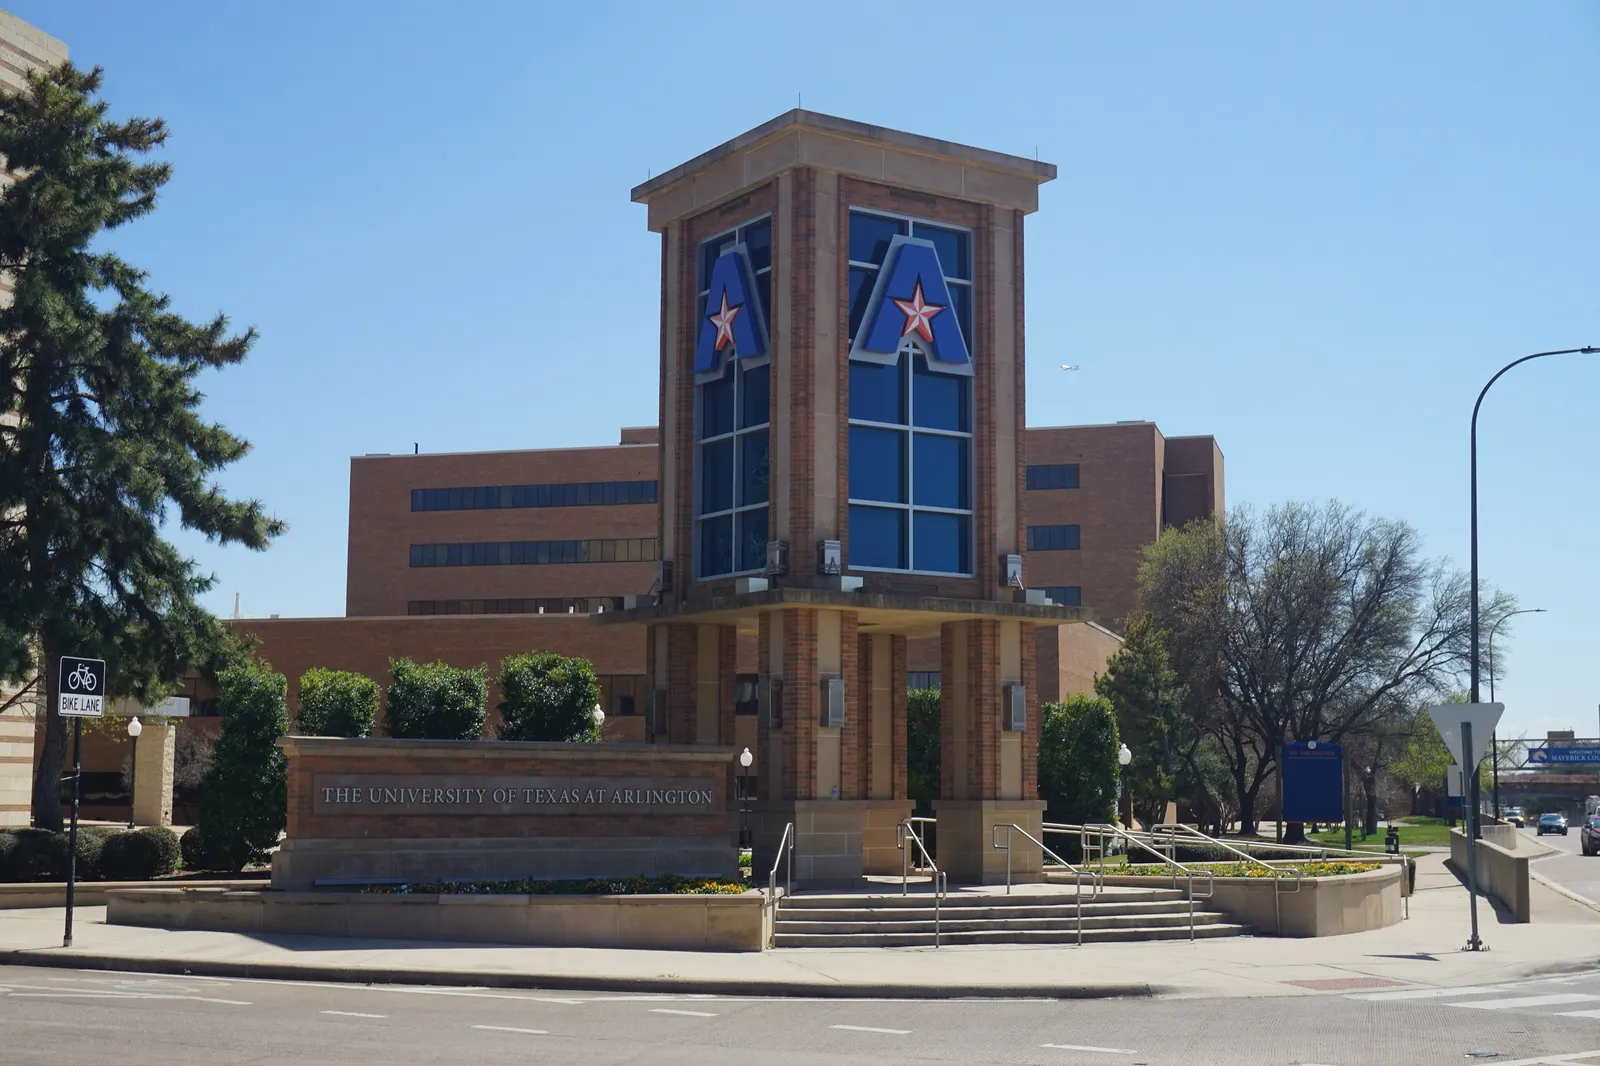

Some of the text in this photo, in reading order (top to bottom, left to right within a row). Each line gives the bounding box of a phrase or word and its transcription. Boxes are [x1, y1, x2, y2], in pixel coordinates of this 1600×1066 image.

[62, 697, 100, 712] BIKE LANE
[321, 787, 713, 804] THE UNIVERSITY OF TEXAS AT ARLINGTON
